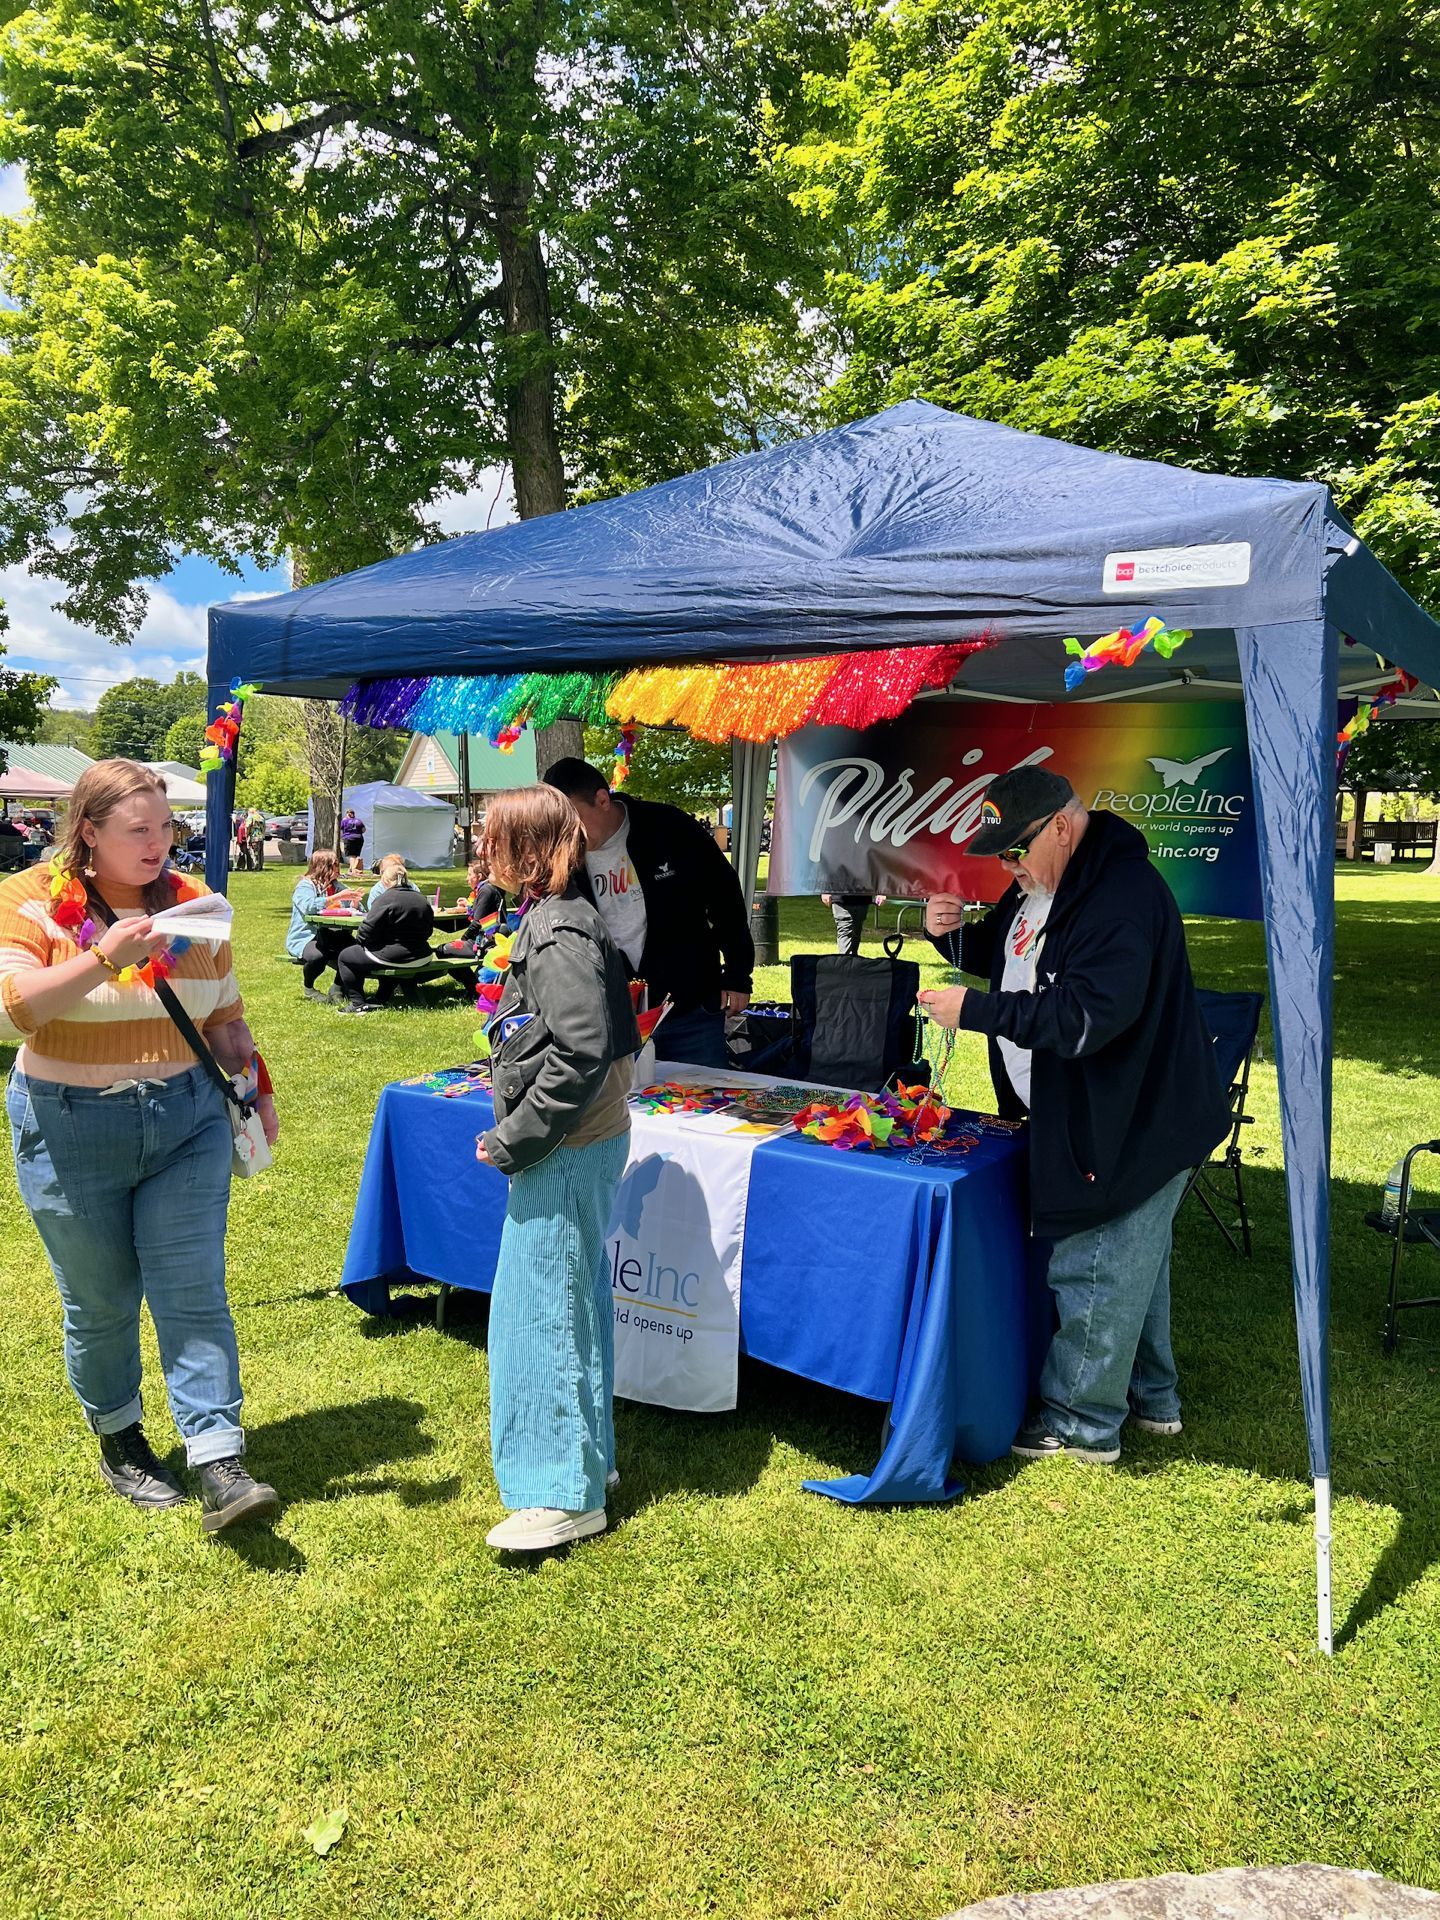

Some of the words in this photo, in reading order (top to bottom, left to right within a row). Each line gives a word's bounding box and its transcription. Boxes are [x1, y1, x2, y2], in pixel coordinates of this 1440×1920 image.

[800, 746, 1055, 863] Prid
[986, 816, 1002, 825] YOU
[1150, 821, 1181, 832] world
[1183, 824, 1216, 836] opens
[1219, 826, 1234, 836] up
[1148, 842, 1220, 862] -inc.org
[633, 1316, 673, 1335] opens
[676, 1327, 693, 1344] up
